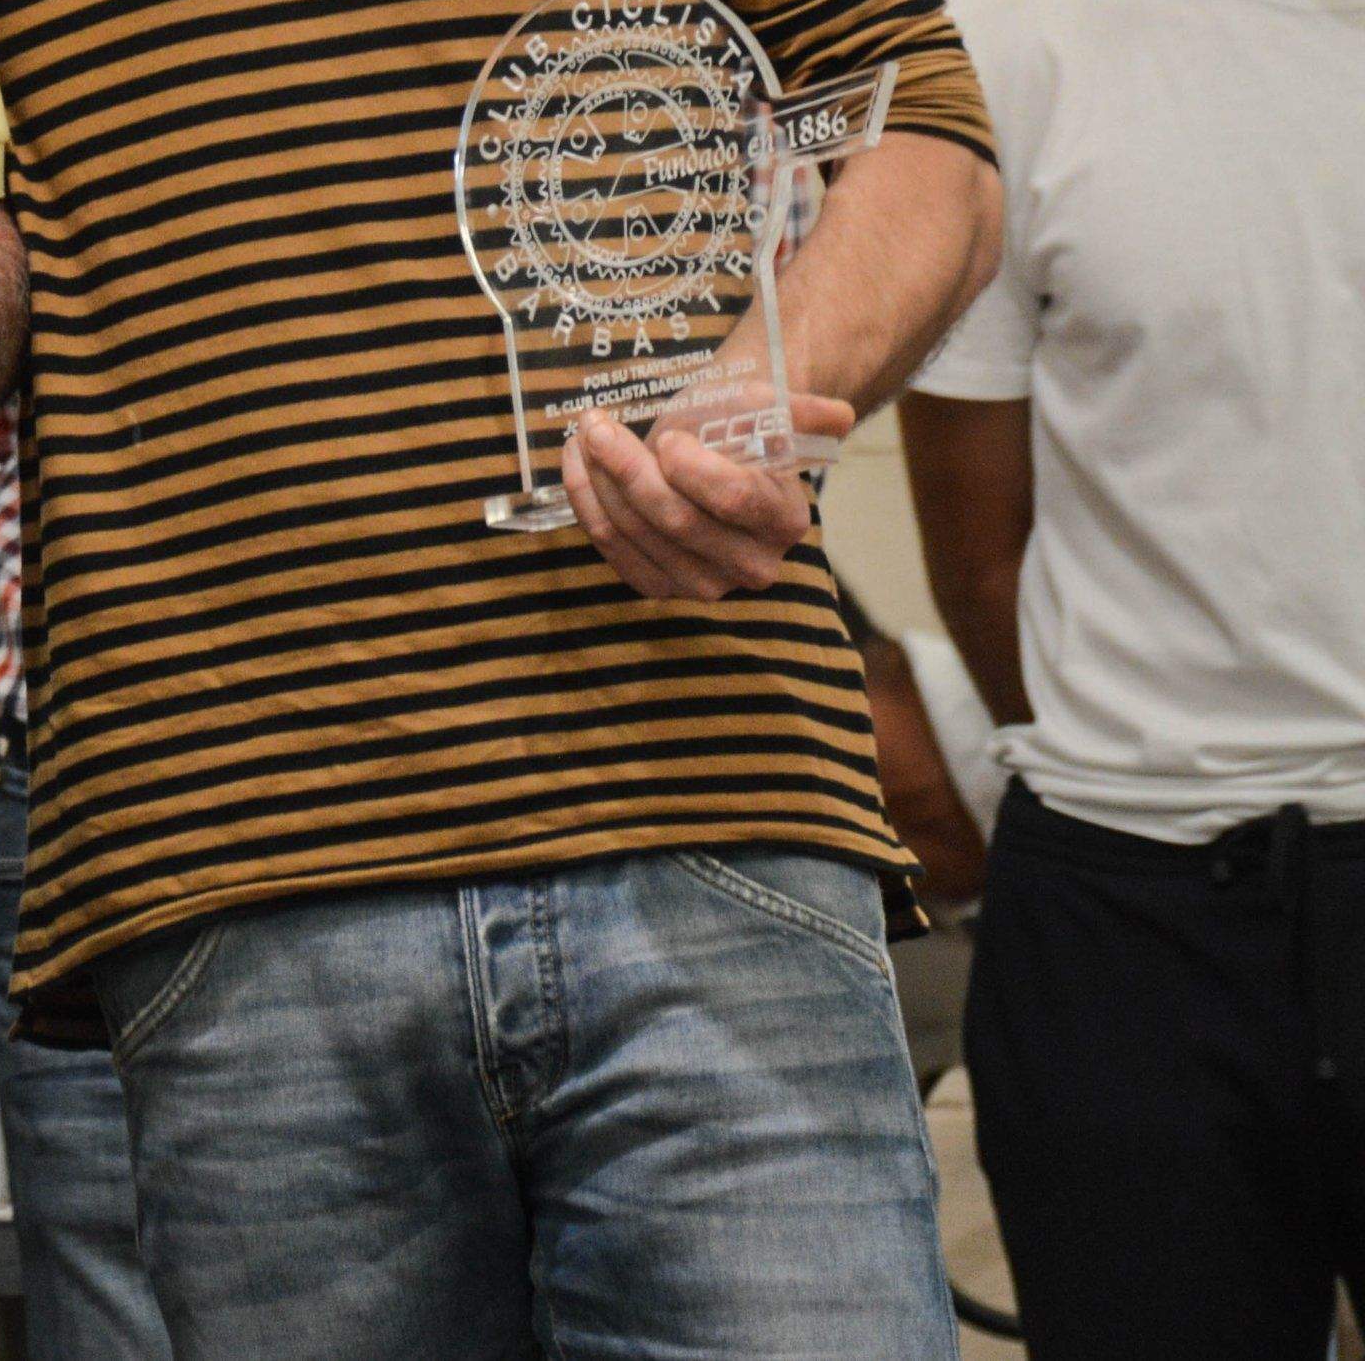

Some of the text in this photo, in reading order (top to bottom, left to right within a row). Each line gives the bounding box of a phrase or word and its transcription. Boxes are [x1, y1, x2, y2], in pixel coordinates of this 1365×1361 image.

[480, 37, 548, 161] CLUB
[644, 106, 848, 187] Fundado en 1886
[495, 205, 768, 357] BARBASTRO
